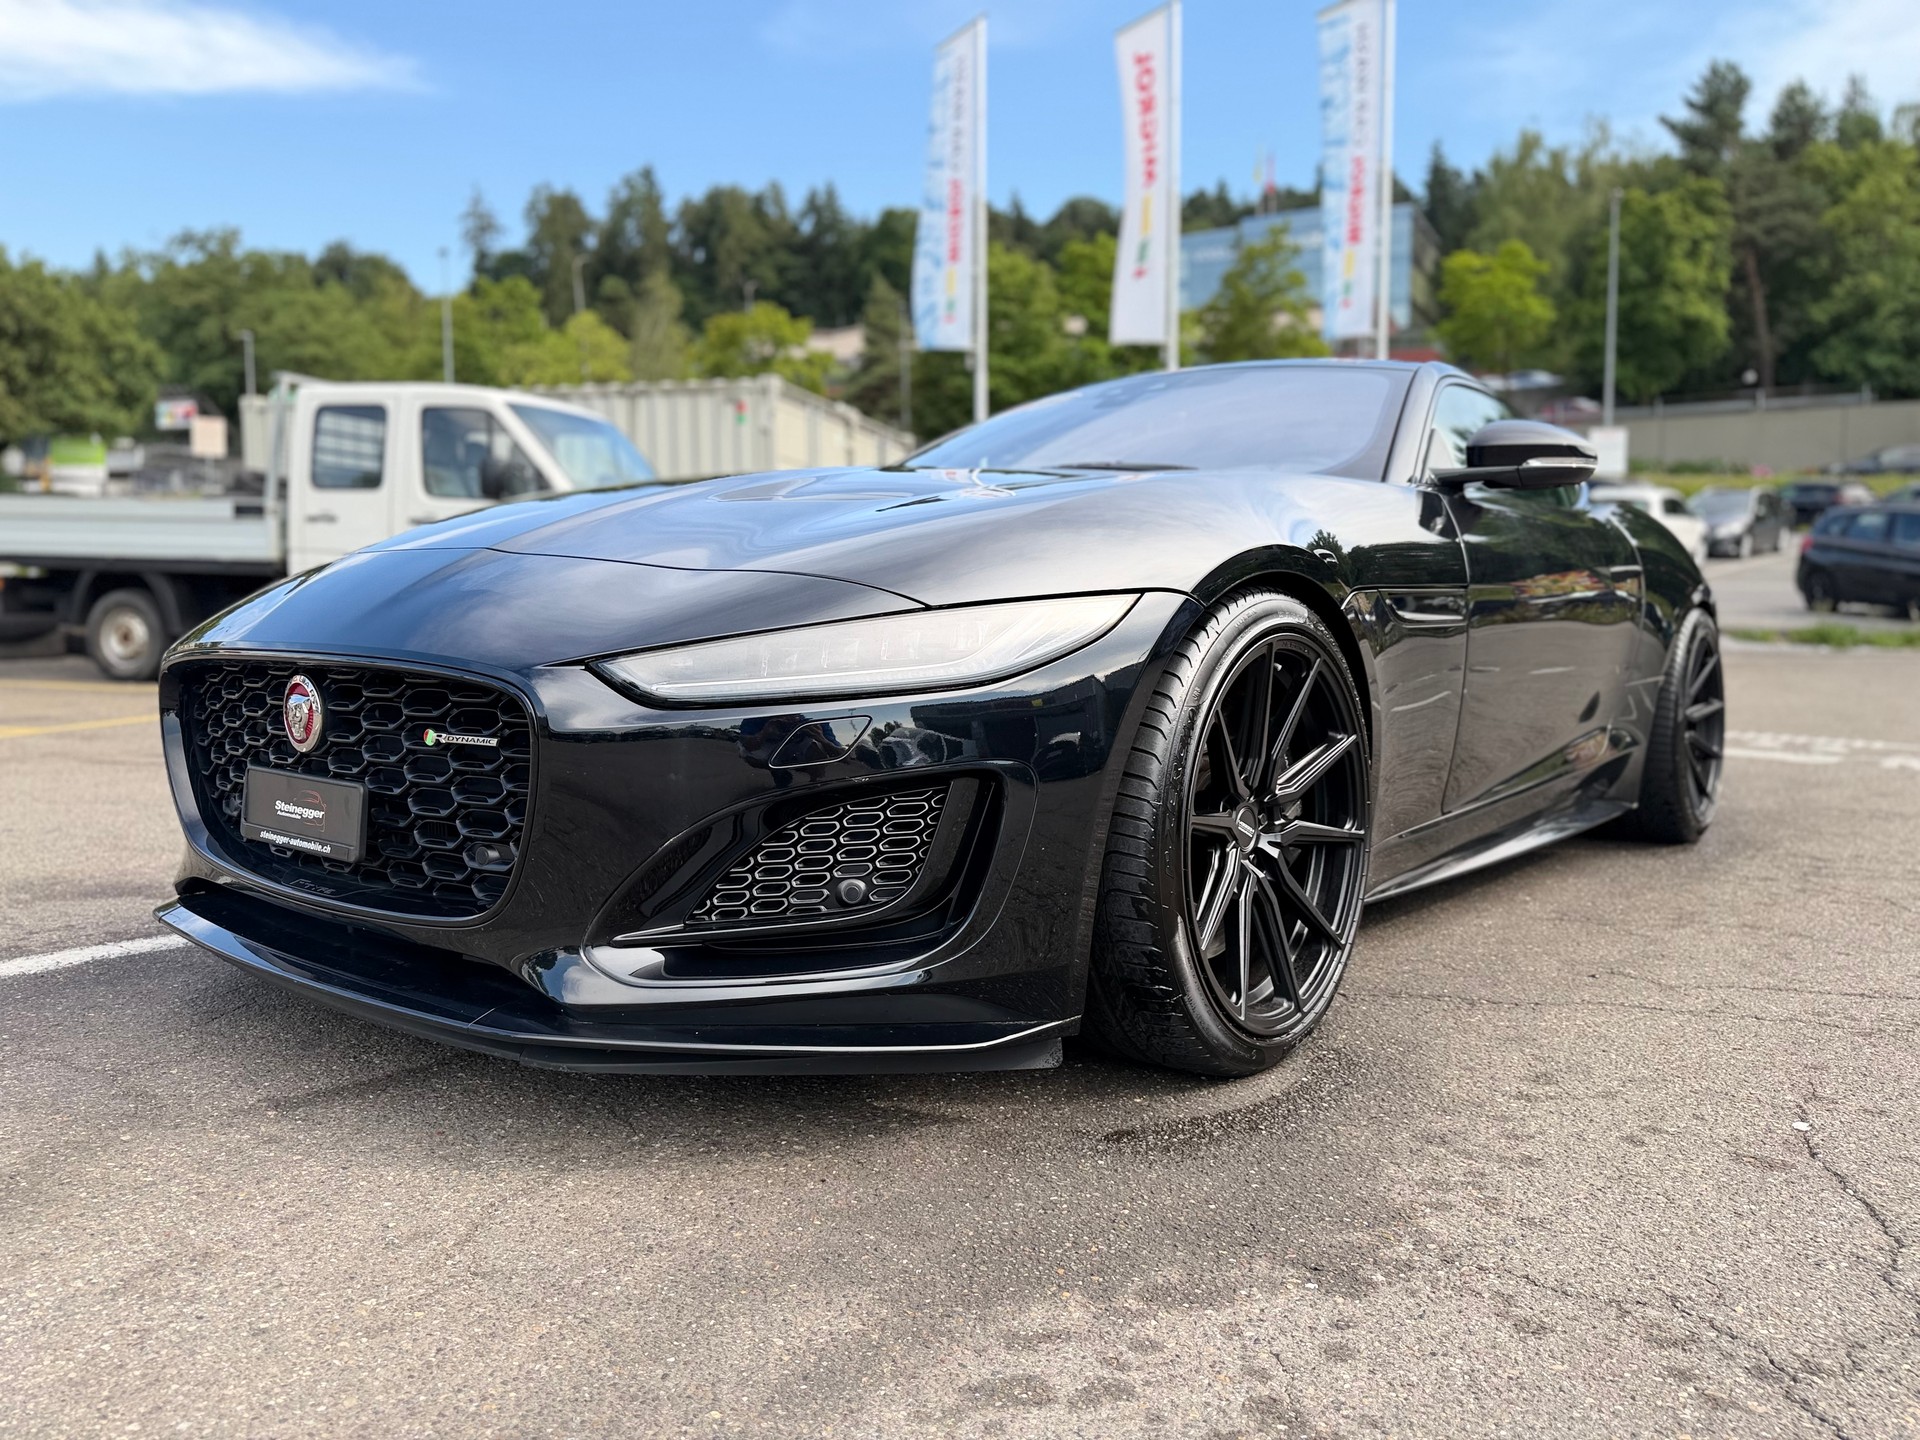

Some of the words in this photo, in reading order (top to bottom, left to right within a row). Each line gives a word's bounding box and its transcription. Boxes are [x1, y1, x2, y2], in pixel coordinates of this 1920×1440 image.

[447, 735, 496, 746] DYNAMIC
[275, 800, 324, 819] Steinegger
[260, 830, 331, 853] steinegger-automobile.ch
